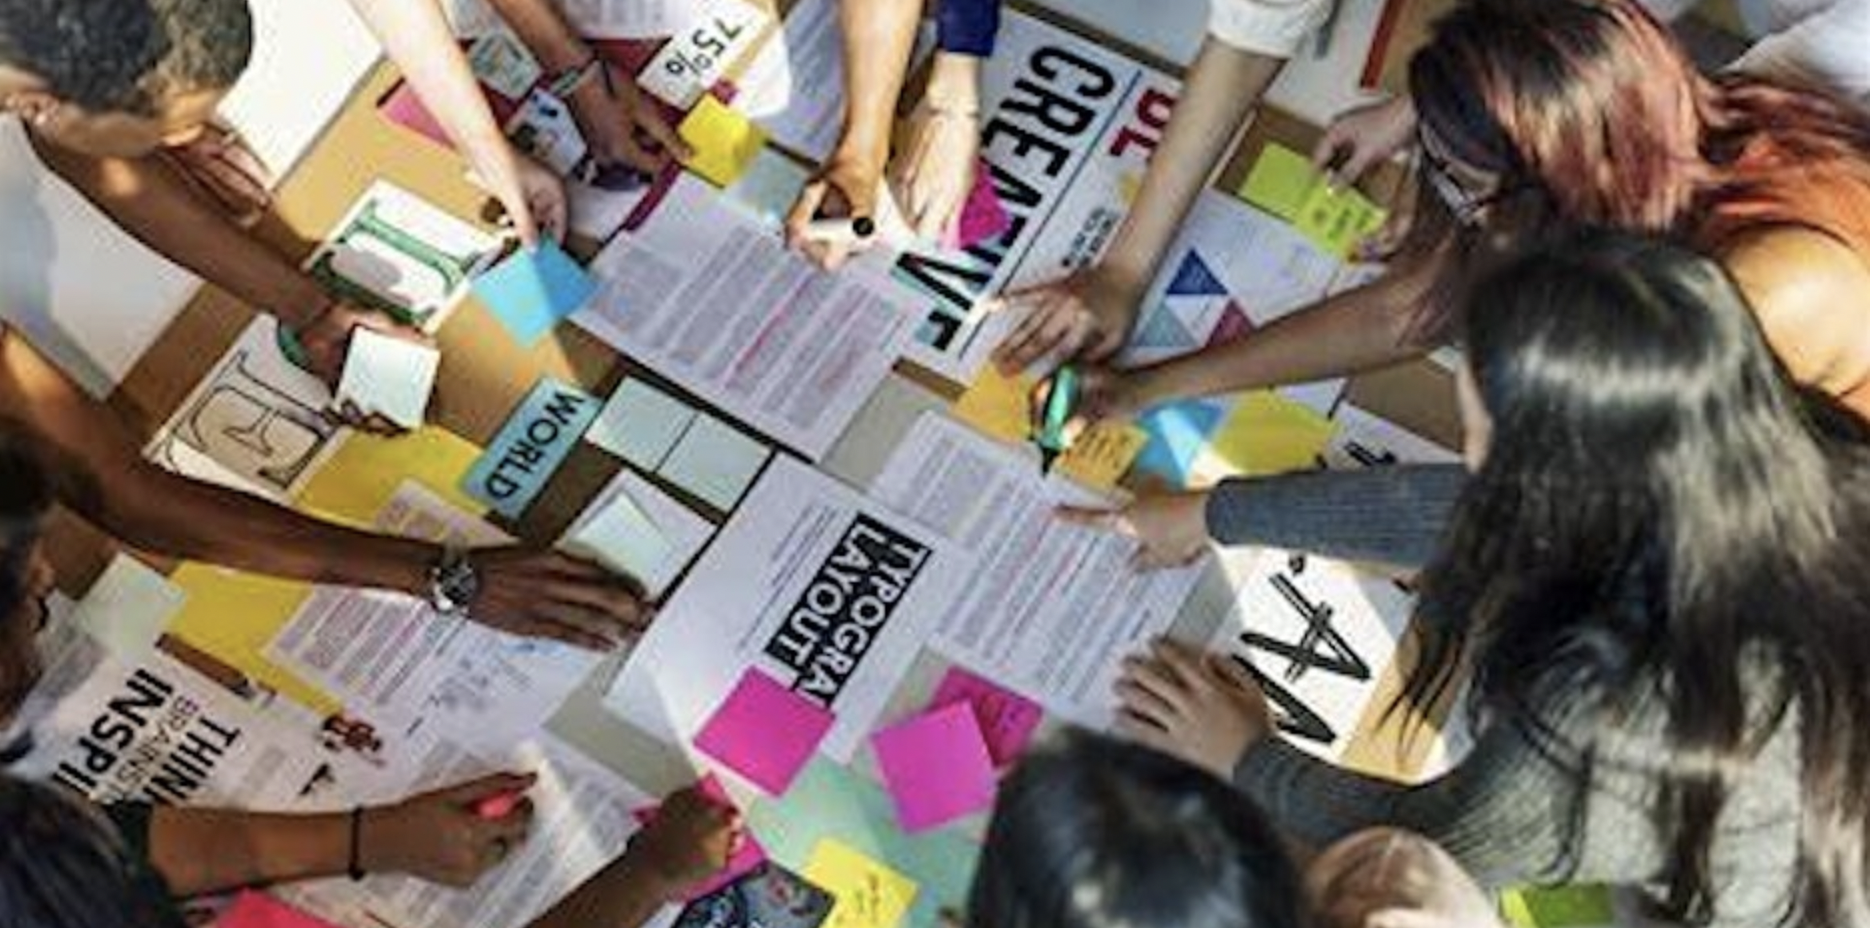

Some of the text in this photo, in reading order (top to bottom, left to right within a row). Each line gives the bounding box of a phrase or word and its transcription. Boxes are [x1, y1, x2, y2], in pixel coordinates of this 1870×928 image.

[664, 17, 743, 75] 75%
[484, 391, 585, 501] WORLD
[777, 523, 874, 667] LAYOUT
